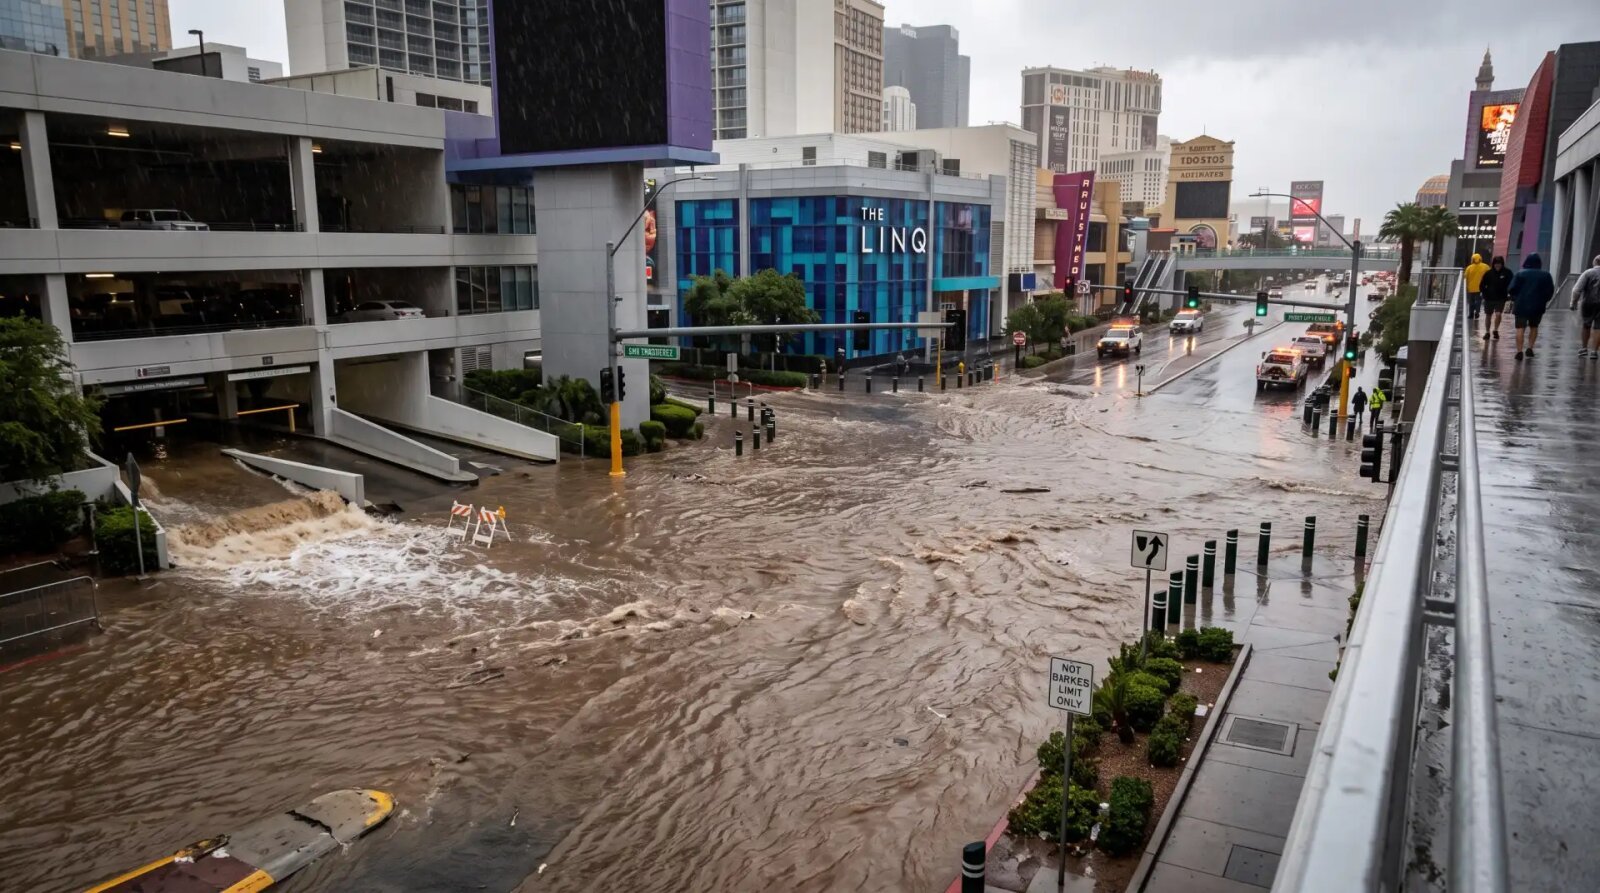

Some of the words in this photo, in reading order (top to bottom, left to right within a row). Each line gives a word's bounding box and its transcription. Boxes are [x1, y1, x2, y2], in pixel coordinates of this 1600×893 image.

[861, 207, 884, 221] THE
[862, 225, 927, 254] LINQ
[1062, 664, 1081, 674] NOT
[1052, 673, 1089, 687] BARKES
[1059, 685, 1082, 697] LIMIT
[1057, 696, 1082, 708] ONLY
